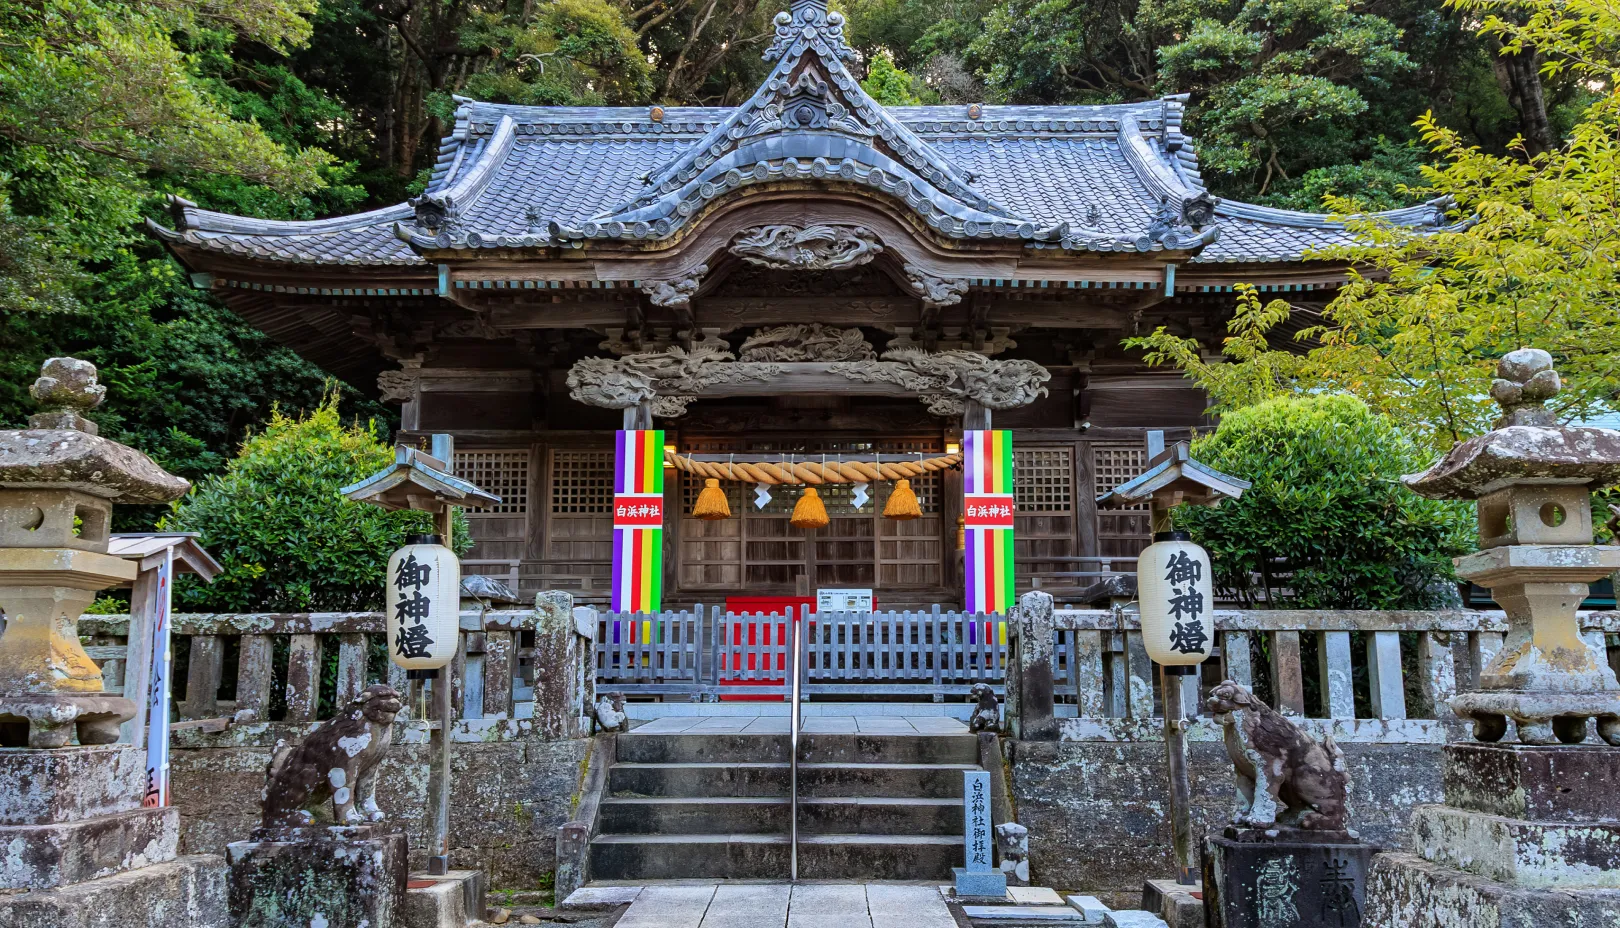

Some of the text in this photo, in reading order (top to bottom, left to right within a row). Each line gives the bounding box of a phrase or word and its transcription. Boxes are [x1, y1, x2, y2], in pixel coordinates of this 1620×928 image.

[616, 504, 661, 518] 白浜神社
[966, 504, 1011, 518] 白浜神社
[393, 554, 434, 659] 御神燈
[1164, 550, 1209, 655] 御神燈
[971, 778, 987, 865] 白浜神社御拝殿
